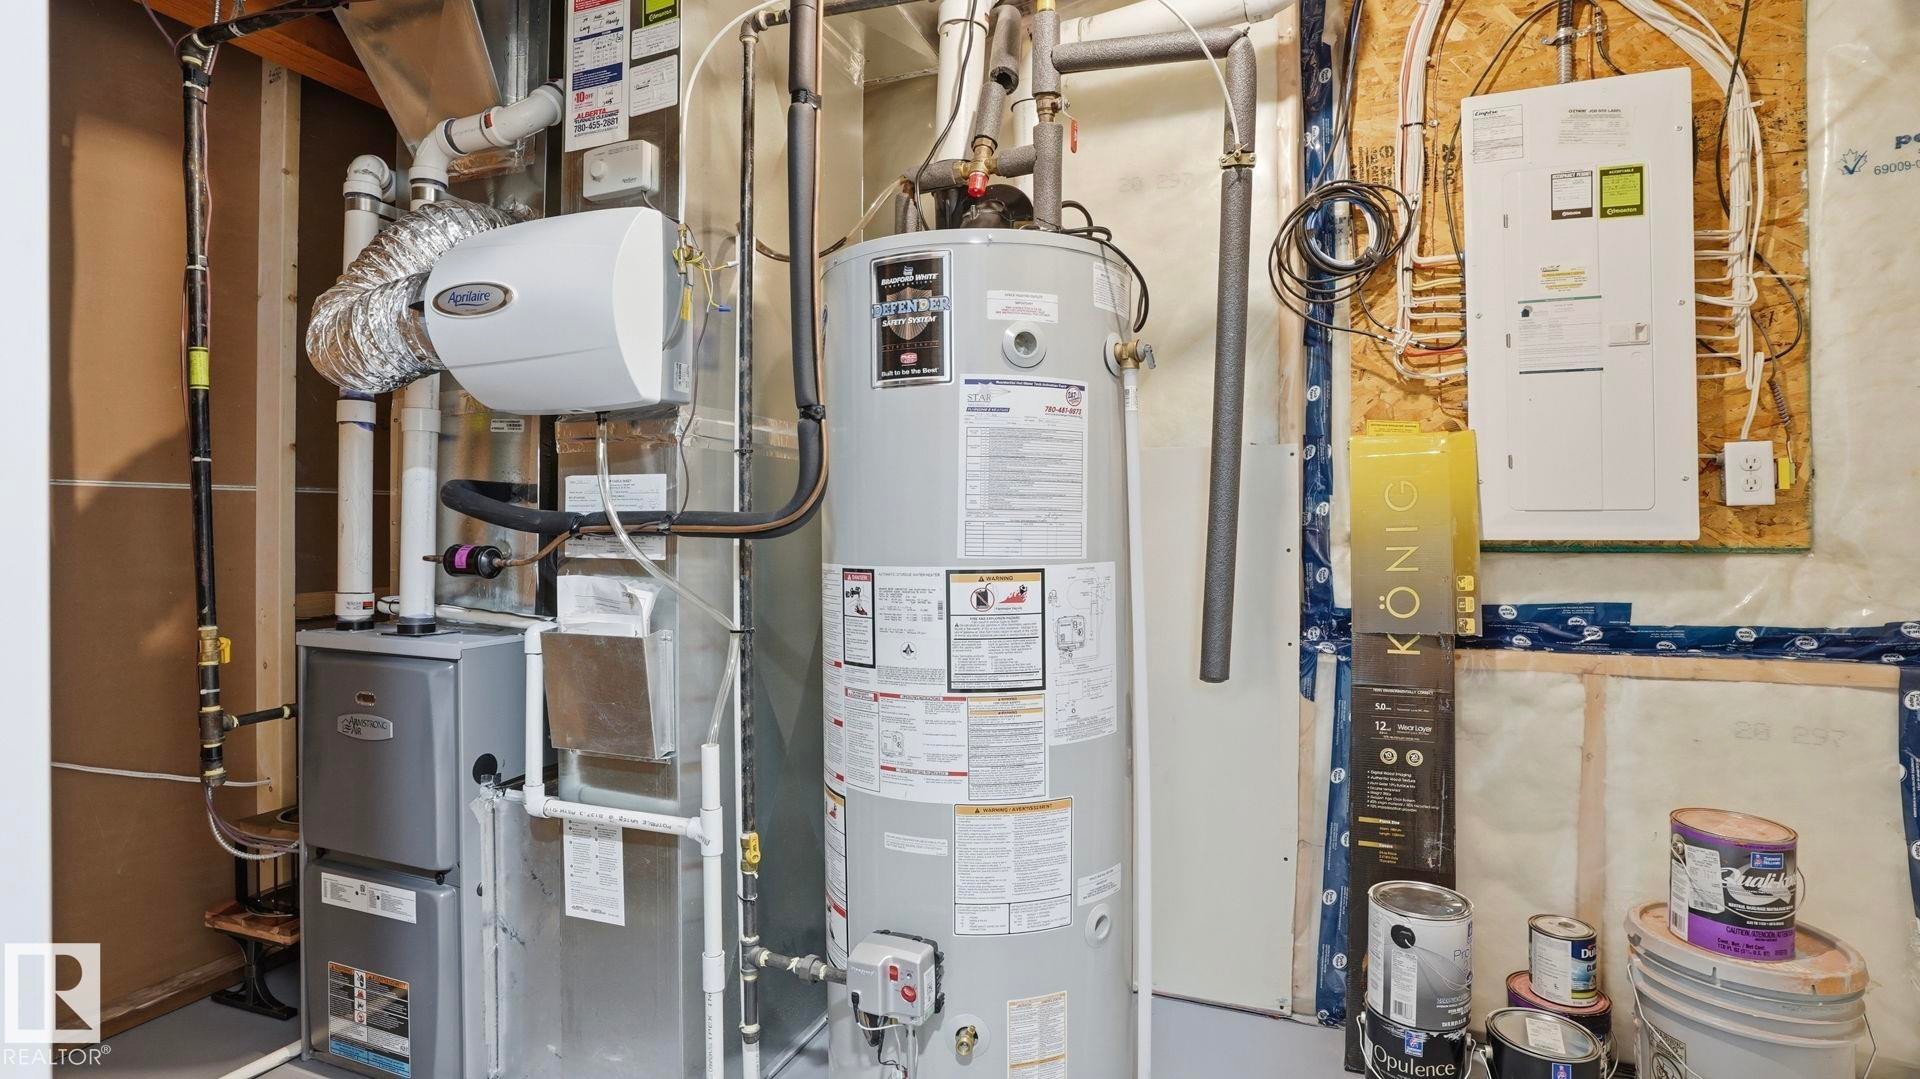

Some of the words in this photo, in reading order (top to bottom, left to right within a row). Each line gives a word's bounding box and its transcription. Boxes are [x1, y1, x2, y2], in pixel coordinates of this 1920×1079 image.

[576, 108, 607, 120] ALBERTA
[1606, 207, 1637, 215] Edmonton
[881, 276, 914, 286] BRADFORD
[915, 273, 939, 281] WHITE
[448, 291, 491, 306] Aprilaire
[872, 296, 951, 318] DEFENDER
[882, 318, 906, 327] SAFETY
[907, 316, 937, 324] SYSTEM
[967, 393, 992, 402] STAR
[1378, 479, 1421, 655] KÖNIG
[351, 716, 388, 730] ARMSTRONG
[1374, 1044, 1457, 1078] Opulence
